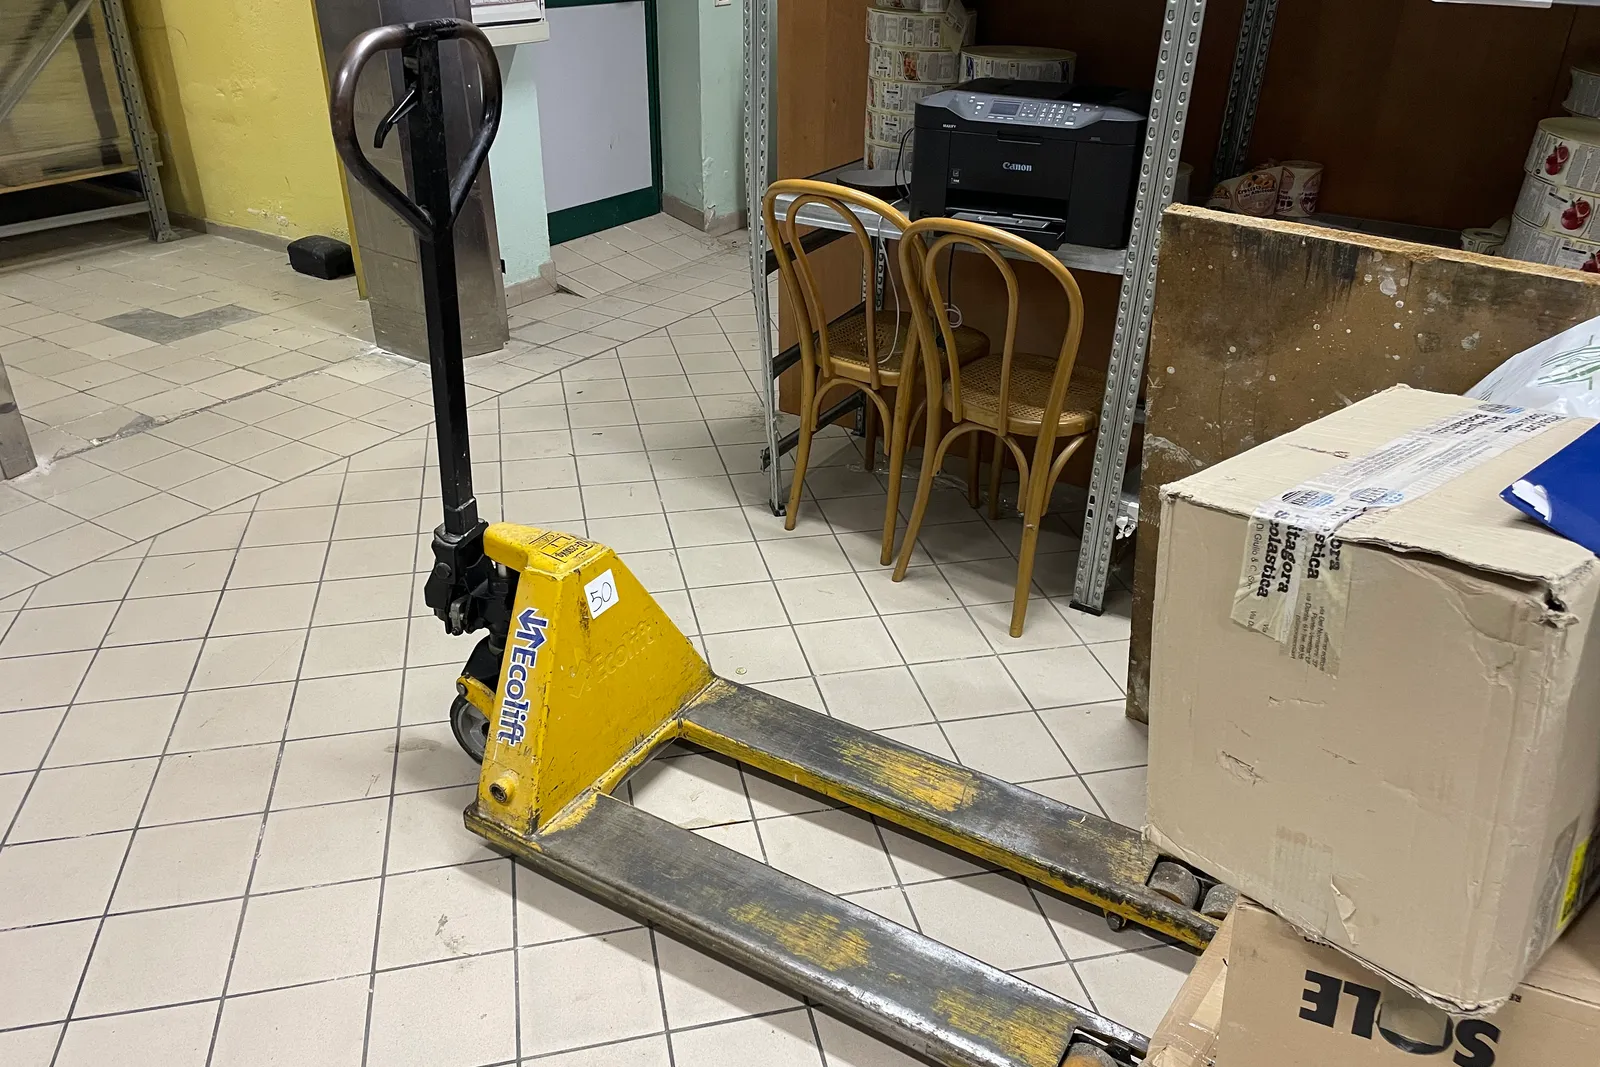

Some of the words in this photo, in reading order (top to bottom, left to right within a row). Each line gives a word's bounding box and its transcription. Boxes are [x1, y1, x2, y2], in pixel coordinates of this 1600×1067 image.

[1002, 161, 1032, 172] Canon
[1277, 514, 1308, 593] itagora
[589, 581, 613, 613] 50
[497, 647, 536, 745] Ecolift
